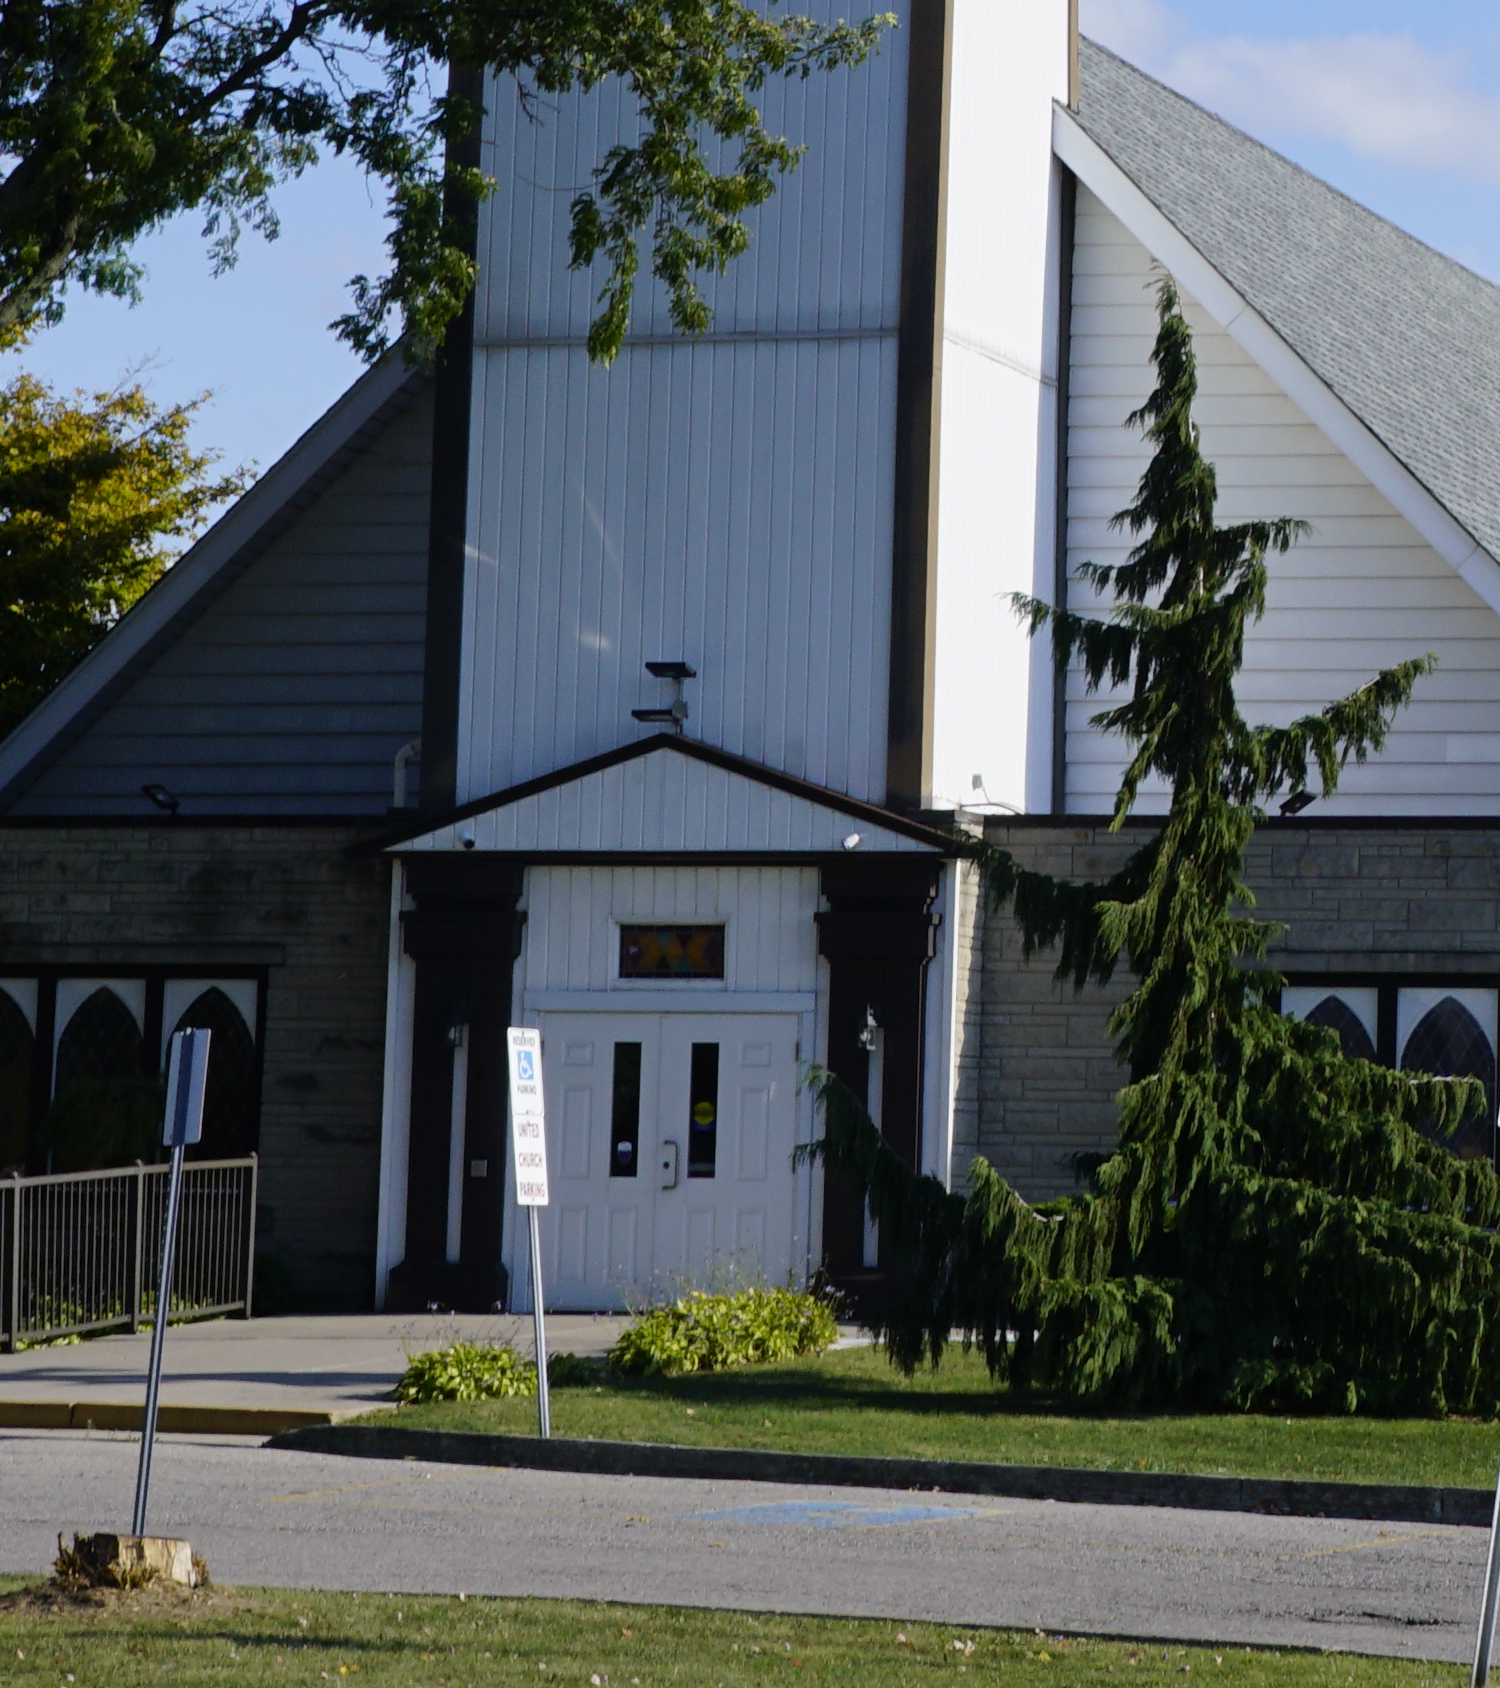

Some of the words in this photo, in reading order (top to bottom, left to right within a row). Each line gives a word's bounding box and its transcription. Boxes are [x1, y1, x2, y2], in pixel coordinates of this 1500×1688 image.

[518, 1122, 540, 1138] UNITED
[518, 1152, 543, 1167] CHURCH
[520, 1181, 545, 1198] PARKING
